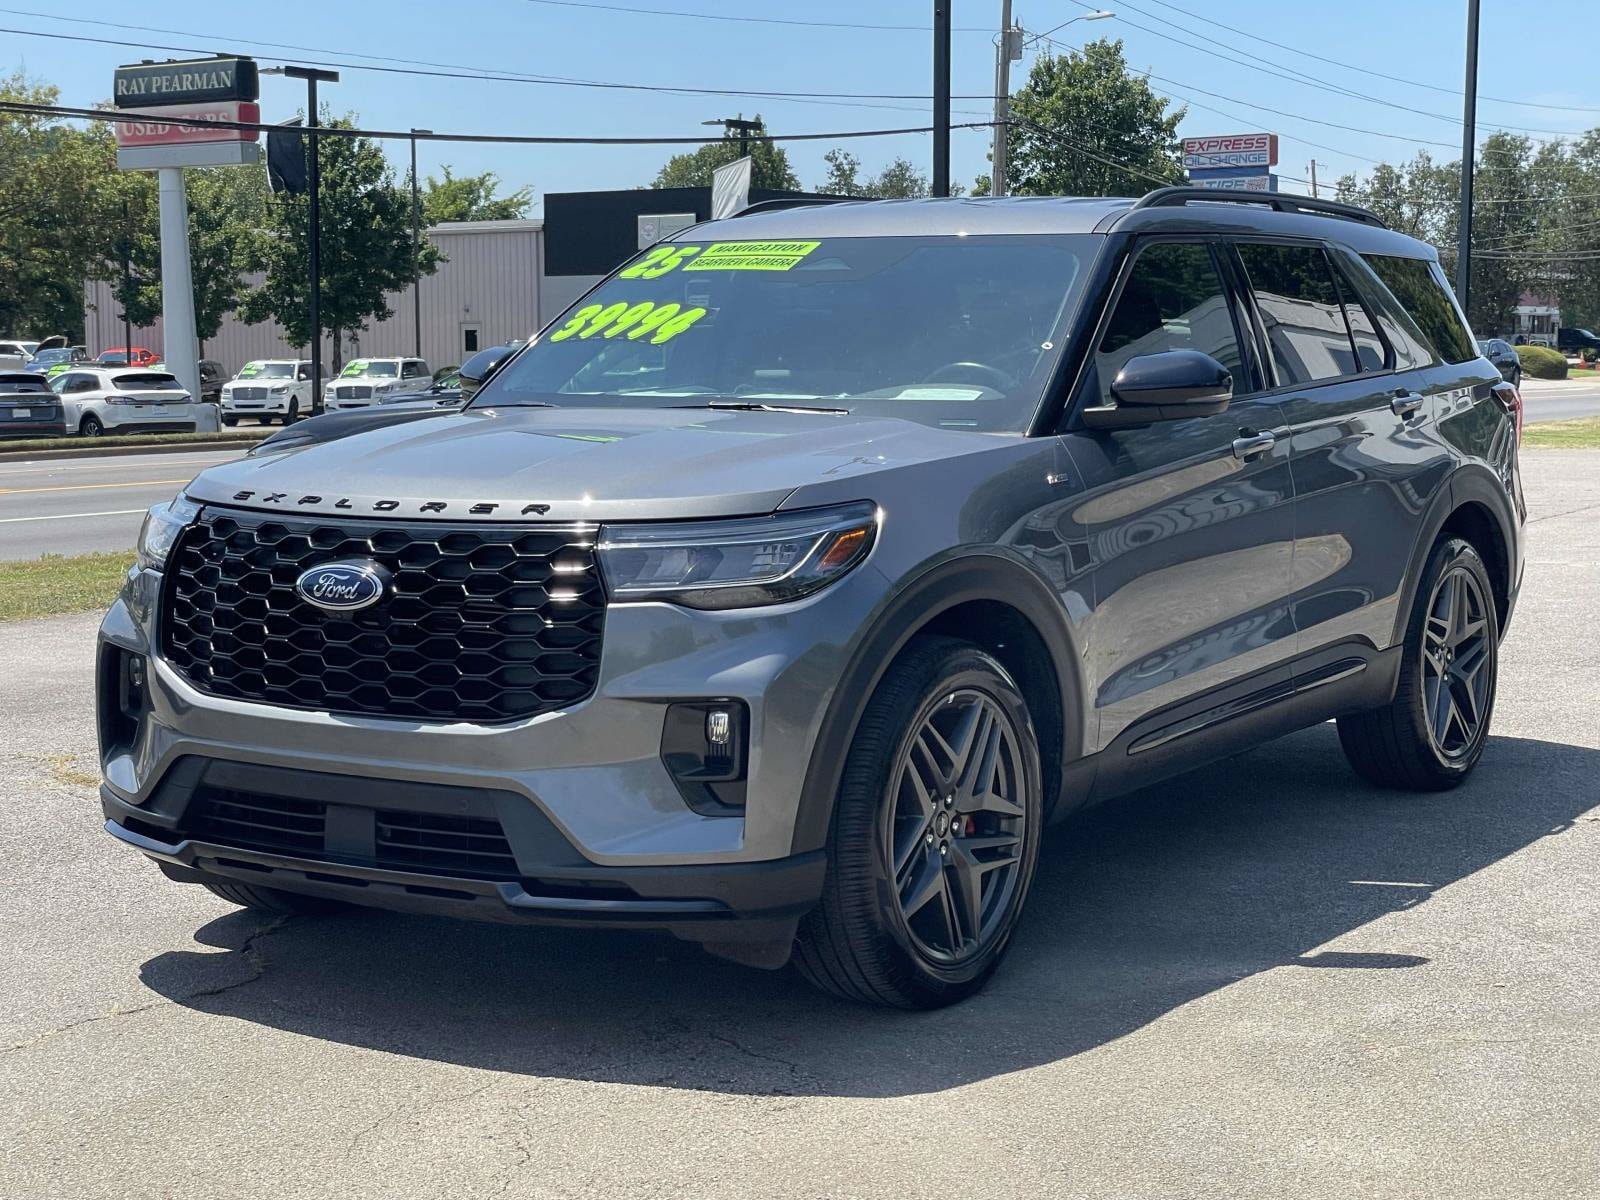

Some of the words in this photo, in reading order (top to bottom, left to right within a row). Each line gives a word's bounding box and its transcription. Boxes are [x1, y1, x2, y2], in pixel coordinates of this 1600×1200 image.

[116, 77, 148, 96] RAY
[151, 70, 232, 93] PEARMAN
[122, 119, 171, 137] USED
[1186, 137, 1267, 152] EXPRESS
[1184, 155, 1204, 167] OIL
[1209, 152, 1267, 166] CHANGE
[712, 244, 810, 253] NAVIGATION
[619, 246, 701, 279] 25
[690, 257, 743, 267] REARVIEW
[745, 257, 797, 267] CAMERA
[550, 302, 706, 344] 39994
[233, 490, 551, 515] EXPLORER
[312, 573, 360, 600] Ford
